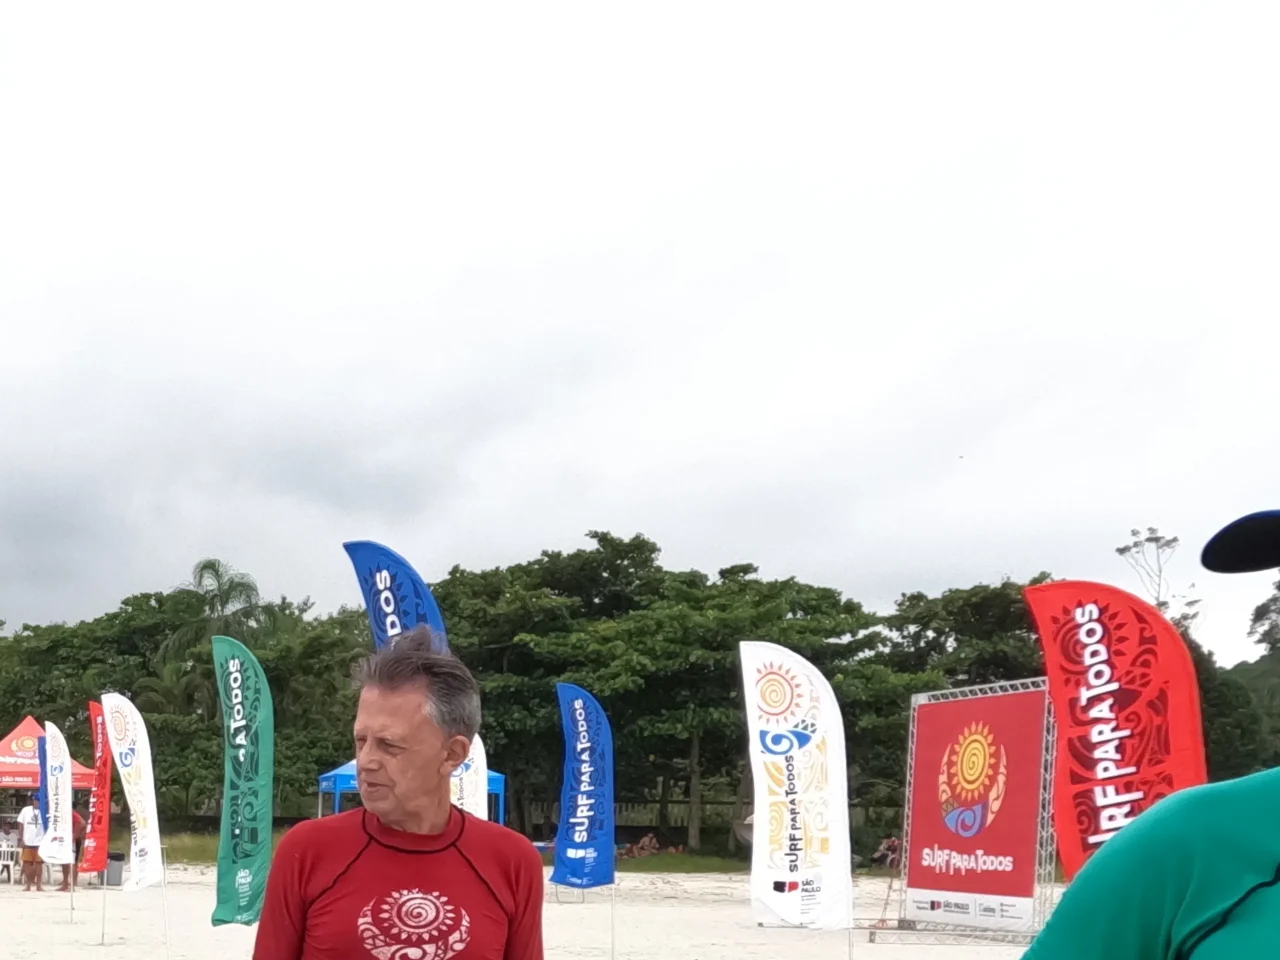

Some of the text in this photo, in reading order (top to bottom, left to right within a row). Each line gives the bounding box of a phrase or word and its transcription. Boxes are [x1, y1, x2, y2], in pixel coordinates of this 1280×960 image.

[376, 569, 402, 637] DOS
[1075, 602, 1120, 706] TODOS
[228, 658, 247, 733] TODOS
[574, 698, 591, 752] TODOS
[579, 751, 595, 791] PARA
[1089, 697, 1137, 780] PARA
[569, 793, 595, 843] SURF
[784, 755, 804, 873] SURF PARA TODOS
[921, 844, 1014, 875] SURF PARA TODOS
